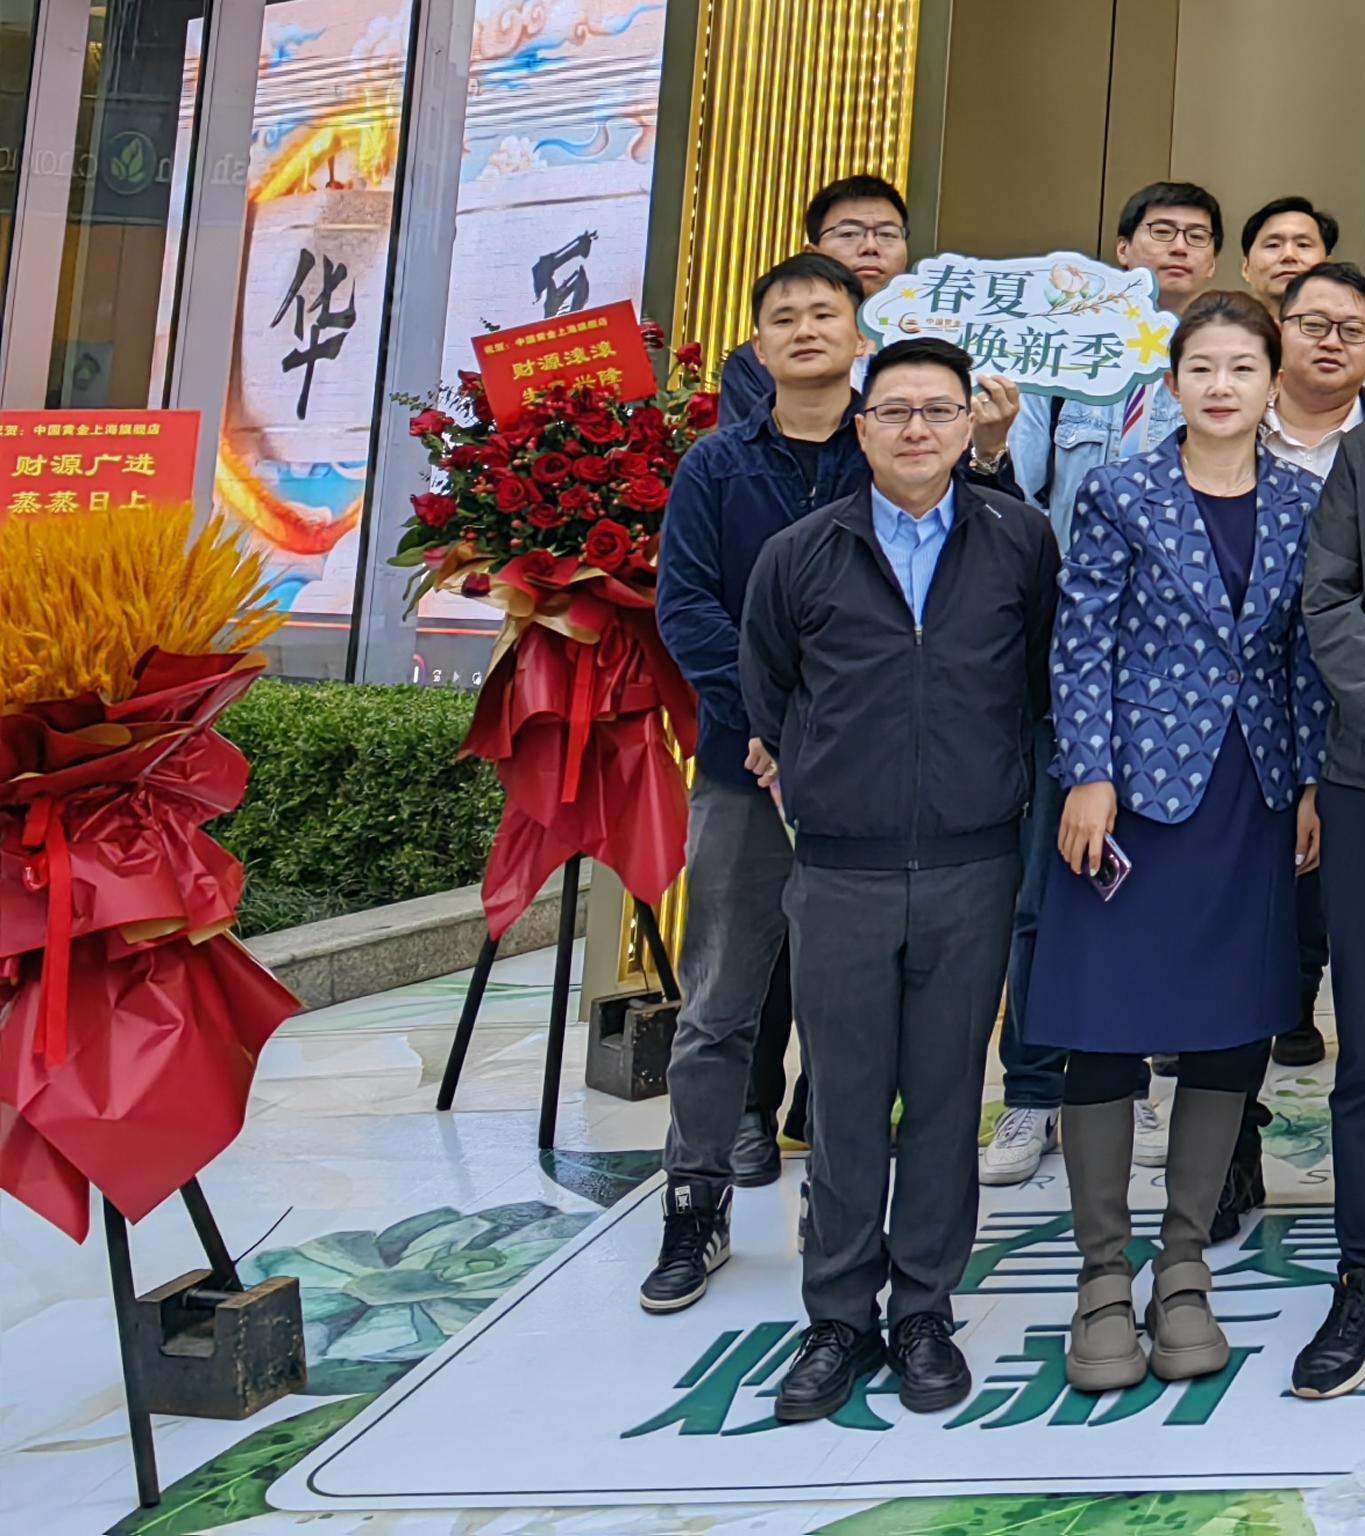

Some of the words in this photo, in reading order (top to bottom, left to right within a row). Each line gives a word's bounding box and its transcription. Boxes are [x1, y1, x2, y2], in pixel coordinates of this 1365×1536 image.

[920, 263, 1035, 319] 春夏
[959, 322, 1126, 380] 焕新季
[11, 453, 157, 477] 财源广进
[7, 489, 149, 513] 蒸蒸日上
